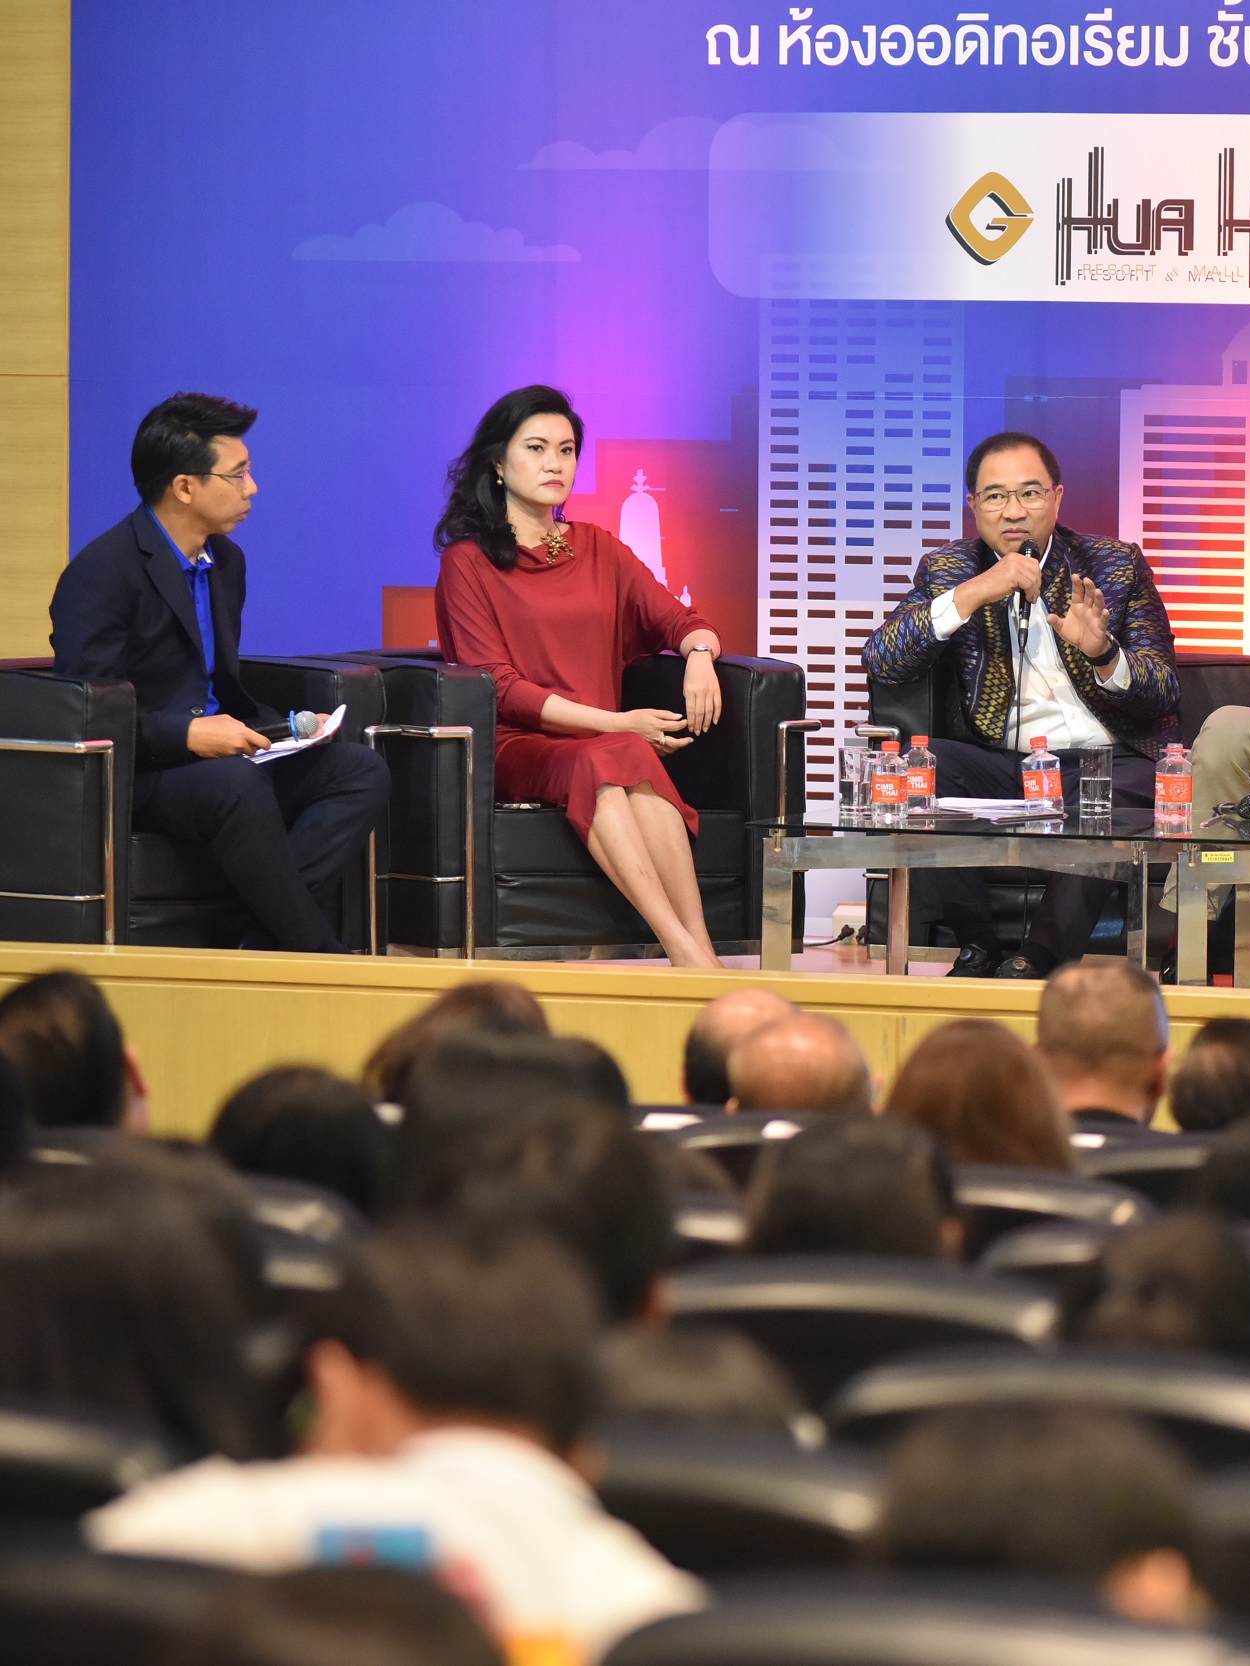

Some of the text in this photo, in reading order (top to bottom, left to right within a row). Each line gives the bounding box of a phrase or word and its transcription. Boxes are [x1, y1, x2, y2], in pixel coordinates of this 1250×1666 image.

[706, 24, 760, 66] ณ
[779, 7, 1189, 67] ห้องออดิทอเรียม
[1055, 146, 1195, 285] HUA
[1079, 264, 1245, 283] RESORT & MALL
[875, 783, 894, 791] CIMB
